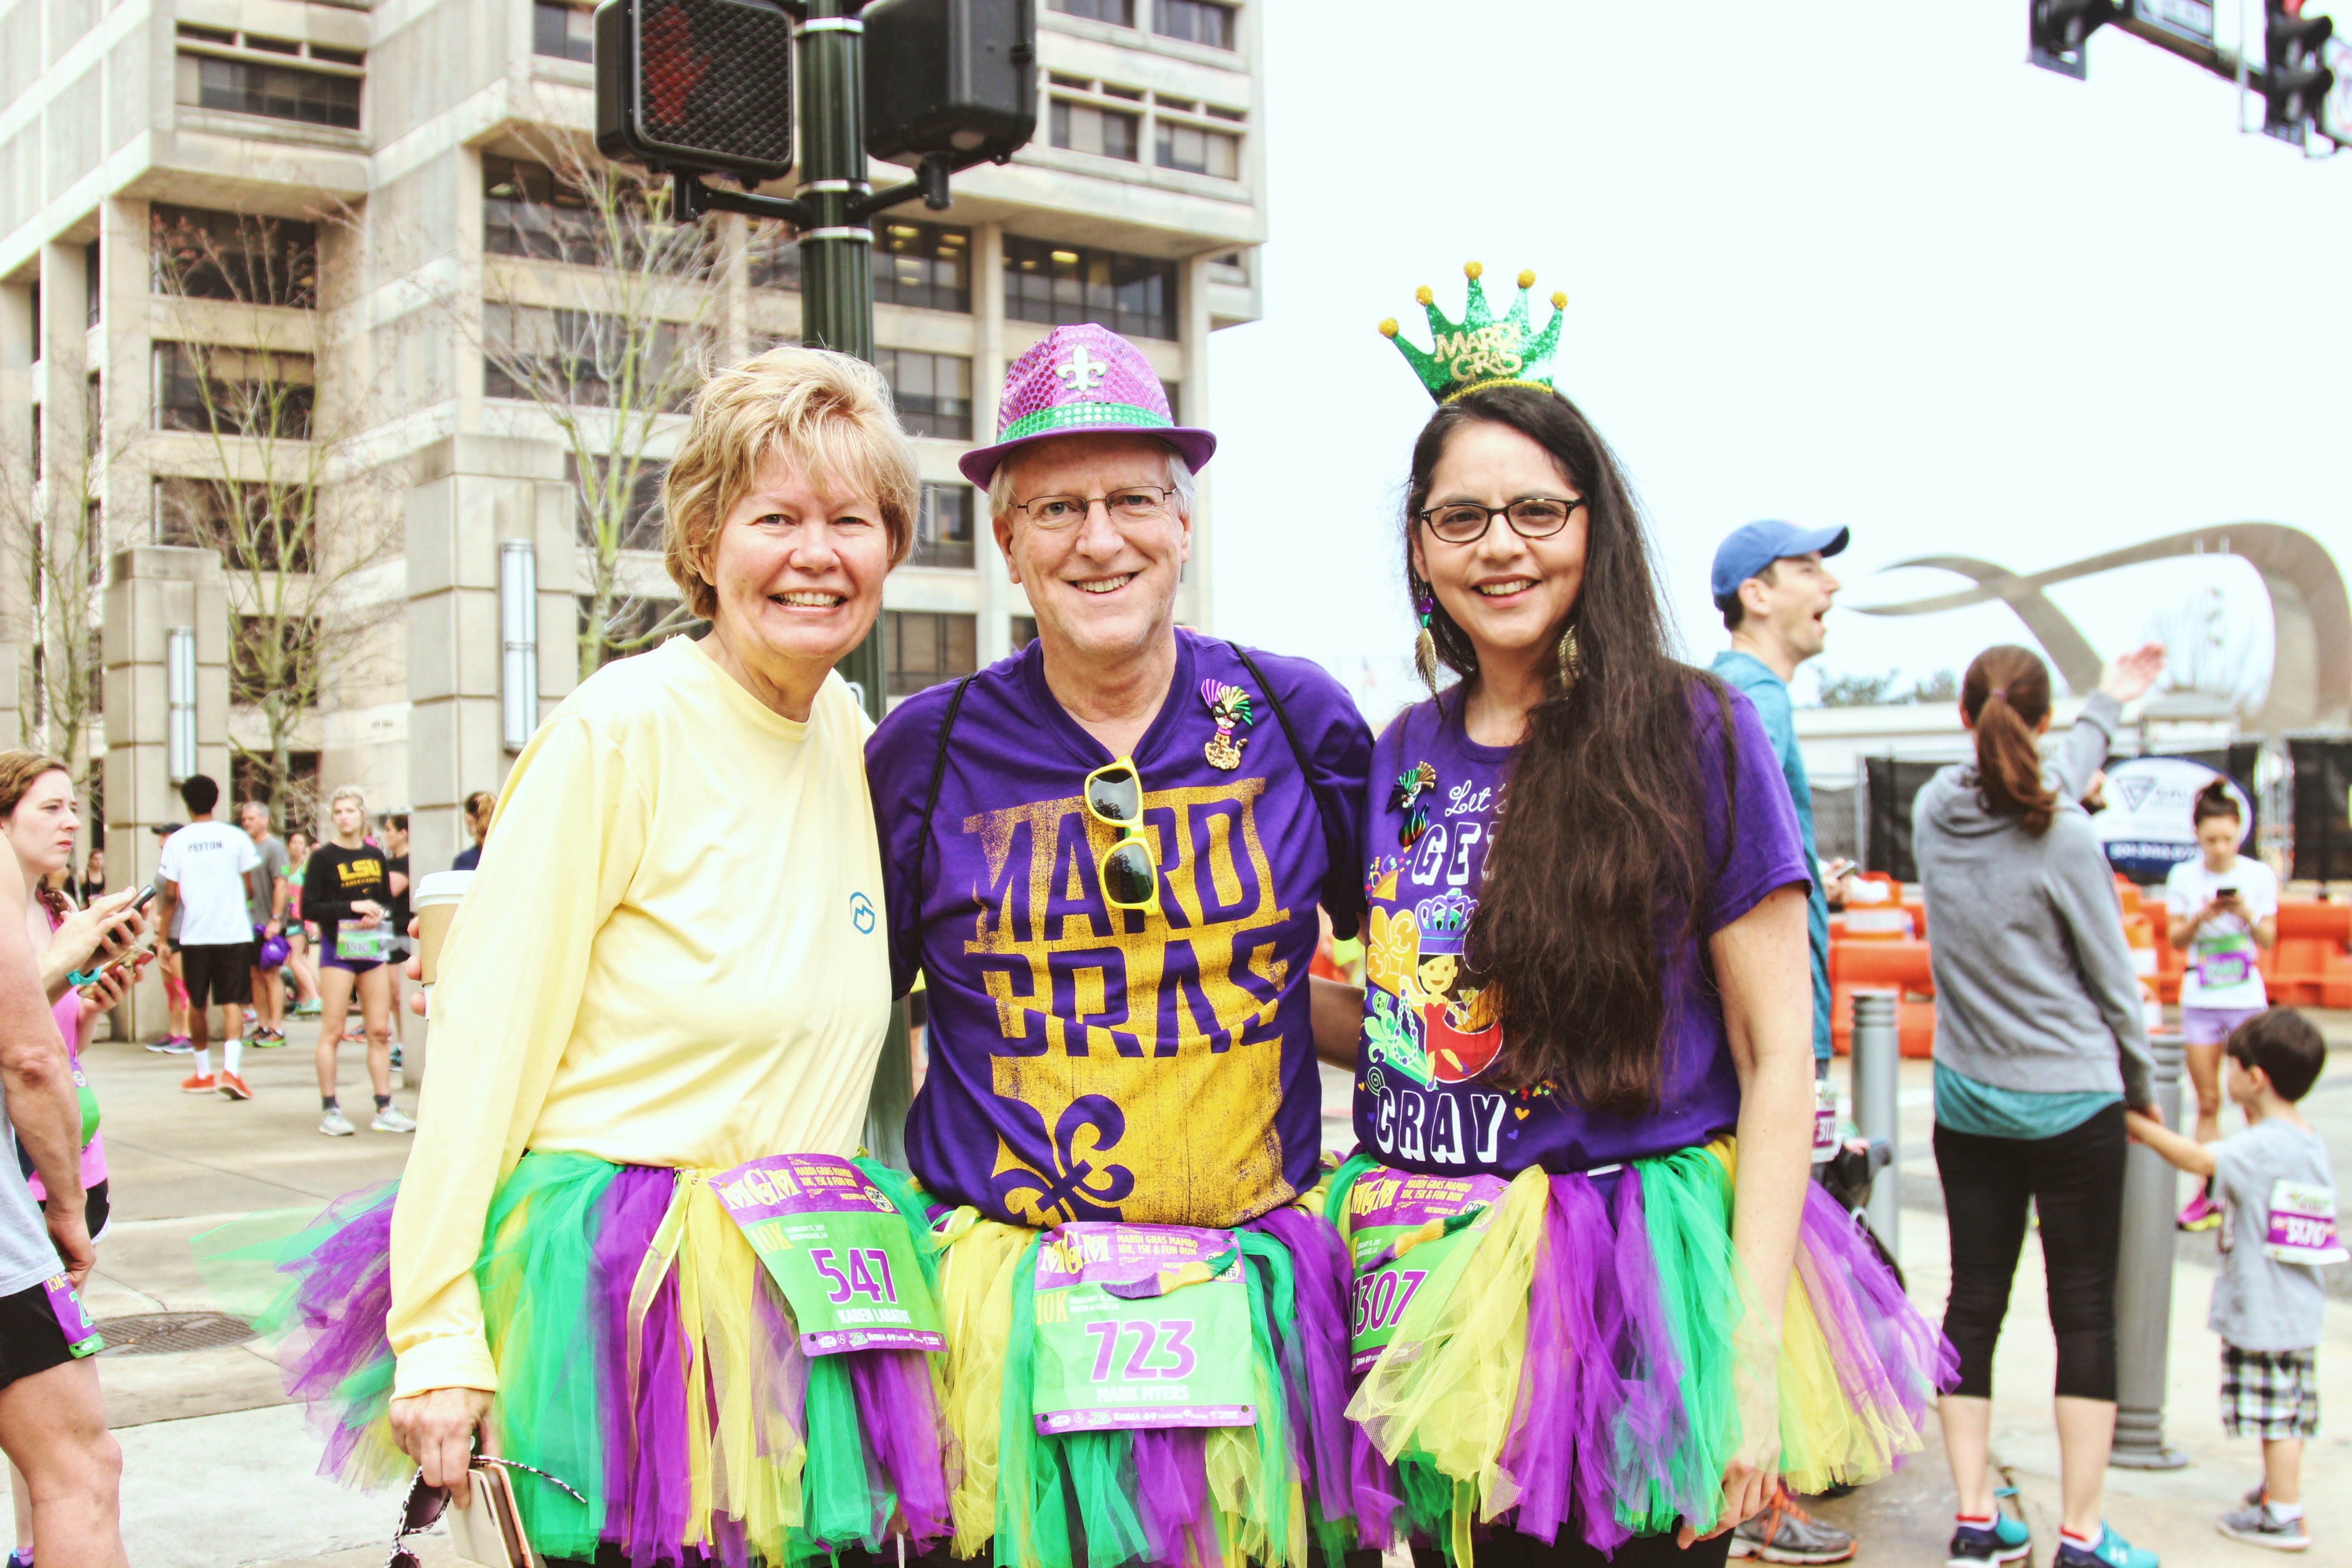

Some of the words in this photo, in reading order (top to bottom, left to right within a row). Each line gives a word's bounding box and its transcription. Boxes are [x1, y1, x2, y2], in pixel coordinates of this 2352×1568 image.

[1434, 323, 1522, 363] MARDI
[1450, 346, 1523, 382] GRAS
[187, 840, 222, 853] PEYTON
[337, 859, 382, 882] LSU
[969, 781, 1289, 943] MARDI
[1375, 1086, 1507, 1164] CRAY
[794, 1166, 817, 1176] MARDI
[815, 1167, 833, 1176] GRAS
[833, 1167, 854, 1179] MAMBO
[814, 1177, 828, 1187] 15K
[827, 1177, 834, 1187] &
[832, 1177, 846, 1187] FUN
[844, 1178, 858, 1188] RUN
[717, 1168, 802, 1210] MGM
[1350, 1175, 1402, 1216] MGM
[1400, 1189, 1413, 1200] 10K,
[1415, 1190, 1426, 1199] 15K
[1425, 1190, 1432, 1199] &
[1431, 1191, 1447, 1200] FUN
[1446, 1192, 1465, 1203] RUN
[1405, 1179, 1427, 1190] MARDI
[1426, 1180, 1445, 1190] GRAS
[1444, 1182, 1473, 1193] MAMBO
[1424, 1206, 1448, 1215] PRESENTED
[749, 1222, 794, 1255] 10K
[1116, 1234, 1144, 1245] MARDI
[1146, 1235, 1168, 1245] GRAS
[1169, 1237, 1199, 1249] MAMBO
[1117, 1244, 1136, 1255] 10K,
[1138, 1245, 1152, 1254] 15K
[1153, 1245, 1160, 1254] &
[1161, 1245, 1178, 1255] FUN
[1180, 1246, 1197, 1256] RUN
[1039, 1230, 1111, 1274] MGM
[808, 1248, 898, 1305] 547
[1036, 1290, 1070, 1326] 10K
[1069, 1295, 1098, 1305] FEBRUARY
[1352, 1269, 1429, 1340] 1307
[836, 1308, 875, 1324] KAREN
[872, 1308, 912, 1324] LABATUT
[1085, 1319, 1197, 1383] 723
[1096, 1387, 1139, 1403] MARK
[1140, 1385, 1189, 1401] MYERS
[1113, 1413, 1141, 1421] SIGMA
